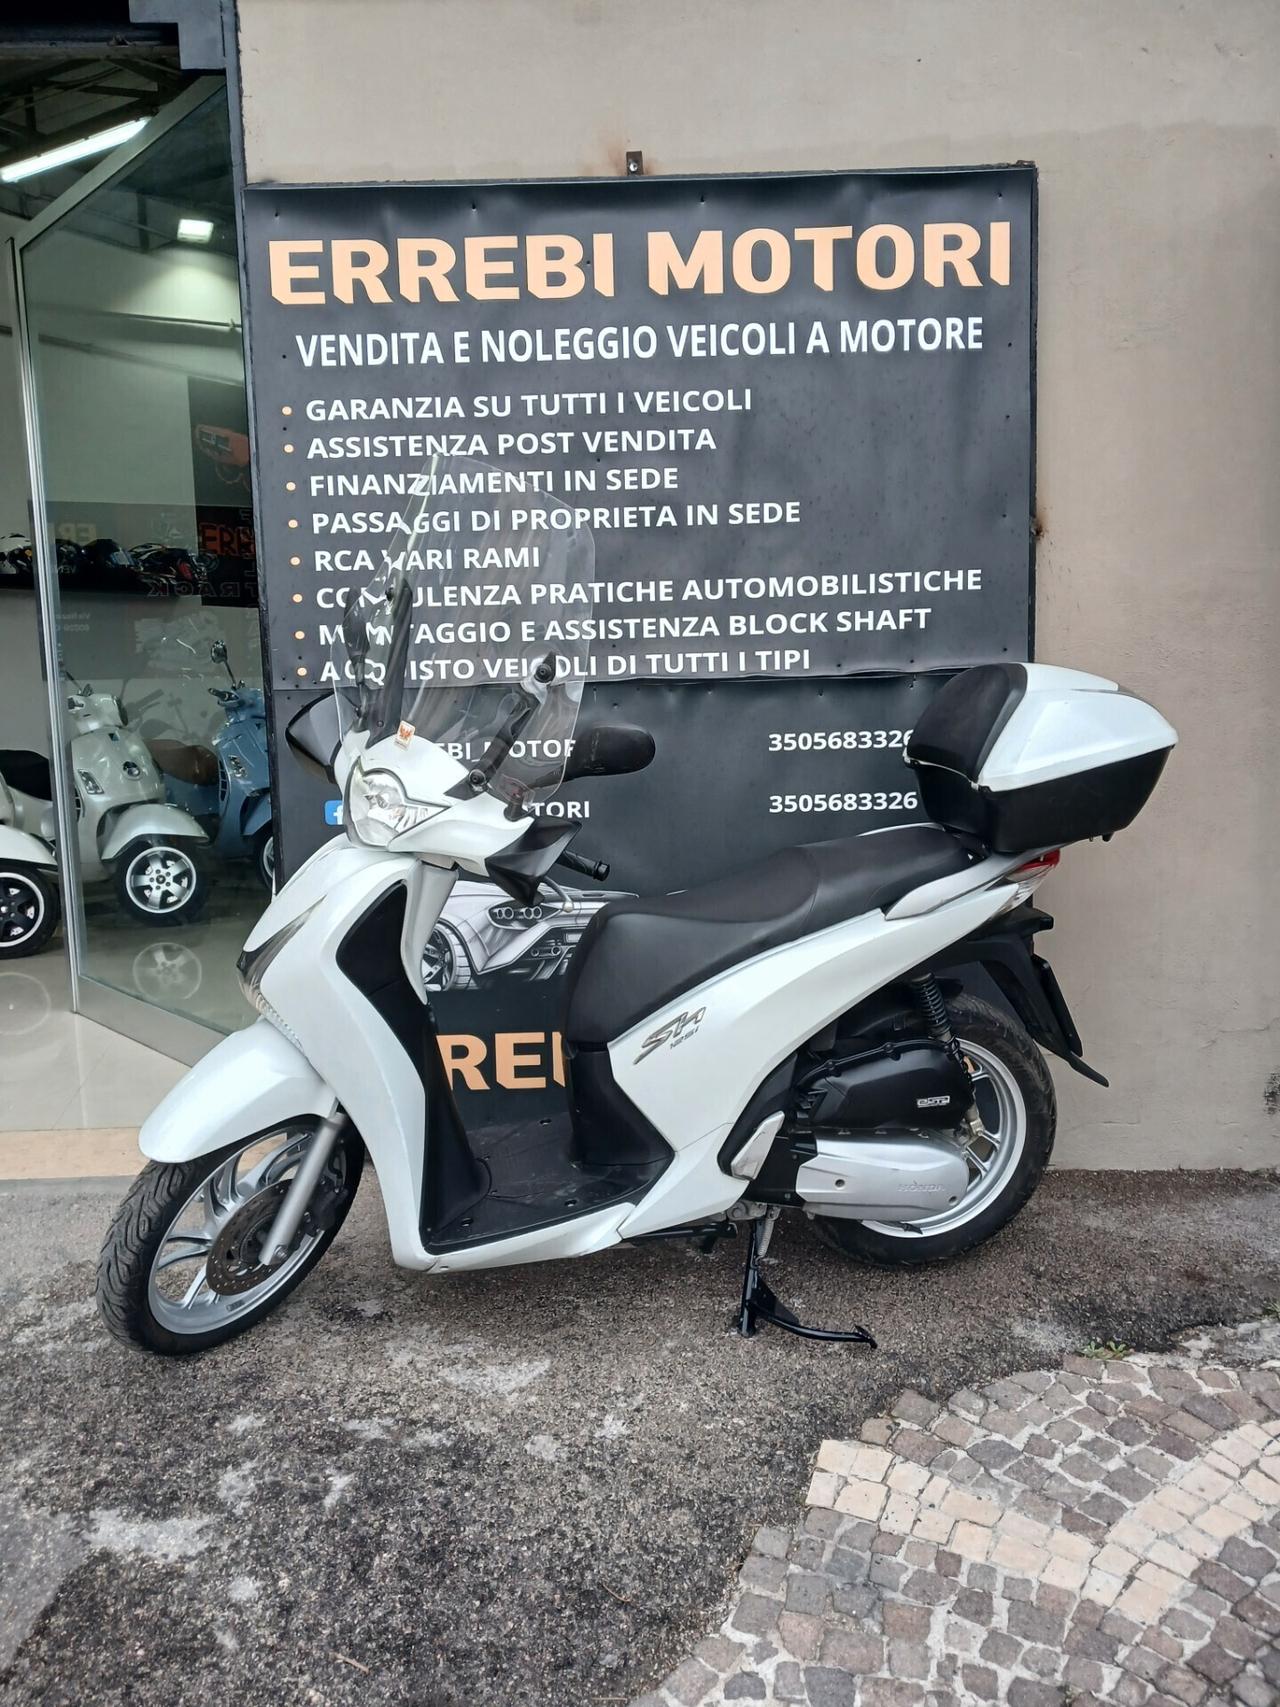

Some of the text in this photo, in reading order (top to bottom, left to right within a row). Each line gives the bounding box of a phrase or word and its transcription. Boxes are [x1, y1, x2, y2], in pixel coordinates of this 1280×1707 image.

[268, 221, 1011, 305] ERREBI MOTORI
[295, 316, 983, 367] VENDITA E NOLEGGIO VEICOLI A MOTORE
[306, 388, 751, 422] GARANZIA SU TUTTI I VEICOLI
[306, 428, 717, 461] ASSISTENZA POST VENDITA
[310, 467, 678, 497] FINANZIAMENTI IN SEDE
[311, 501, 801, 535] PASSAGGI DI PROPRIETA IN SEDE
[314, 550, 375, 572] RCA
[463, 546, 540, 570] RAMI
[316, 569, 982, 609] CONULENZA PRATICHE AUTOMOBILISTICHE
[520, 620, 537, 643] E
[543, 616, 720, 642] ASSISTENZA
[729, 612, 828, 636] BLOCK
[836, 607, 932, 632] SHAFT
[320, 659, 475, 686] ACQISTO
[607, 654, 636, 676] DI
[645, 652, 728, 674] TUTTI
[739, 651, 746, 672] I
[754, 649, 810, 671] TIPI
[769, 791, 918, 813] 3505683326
